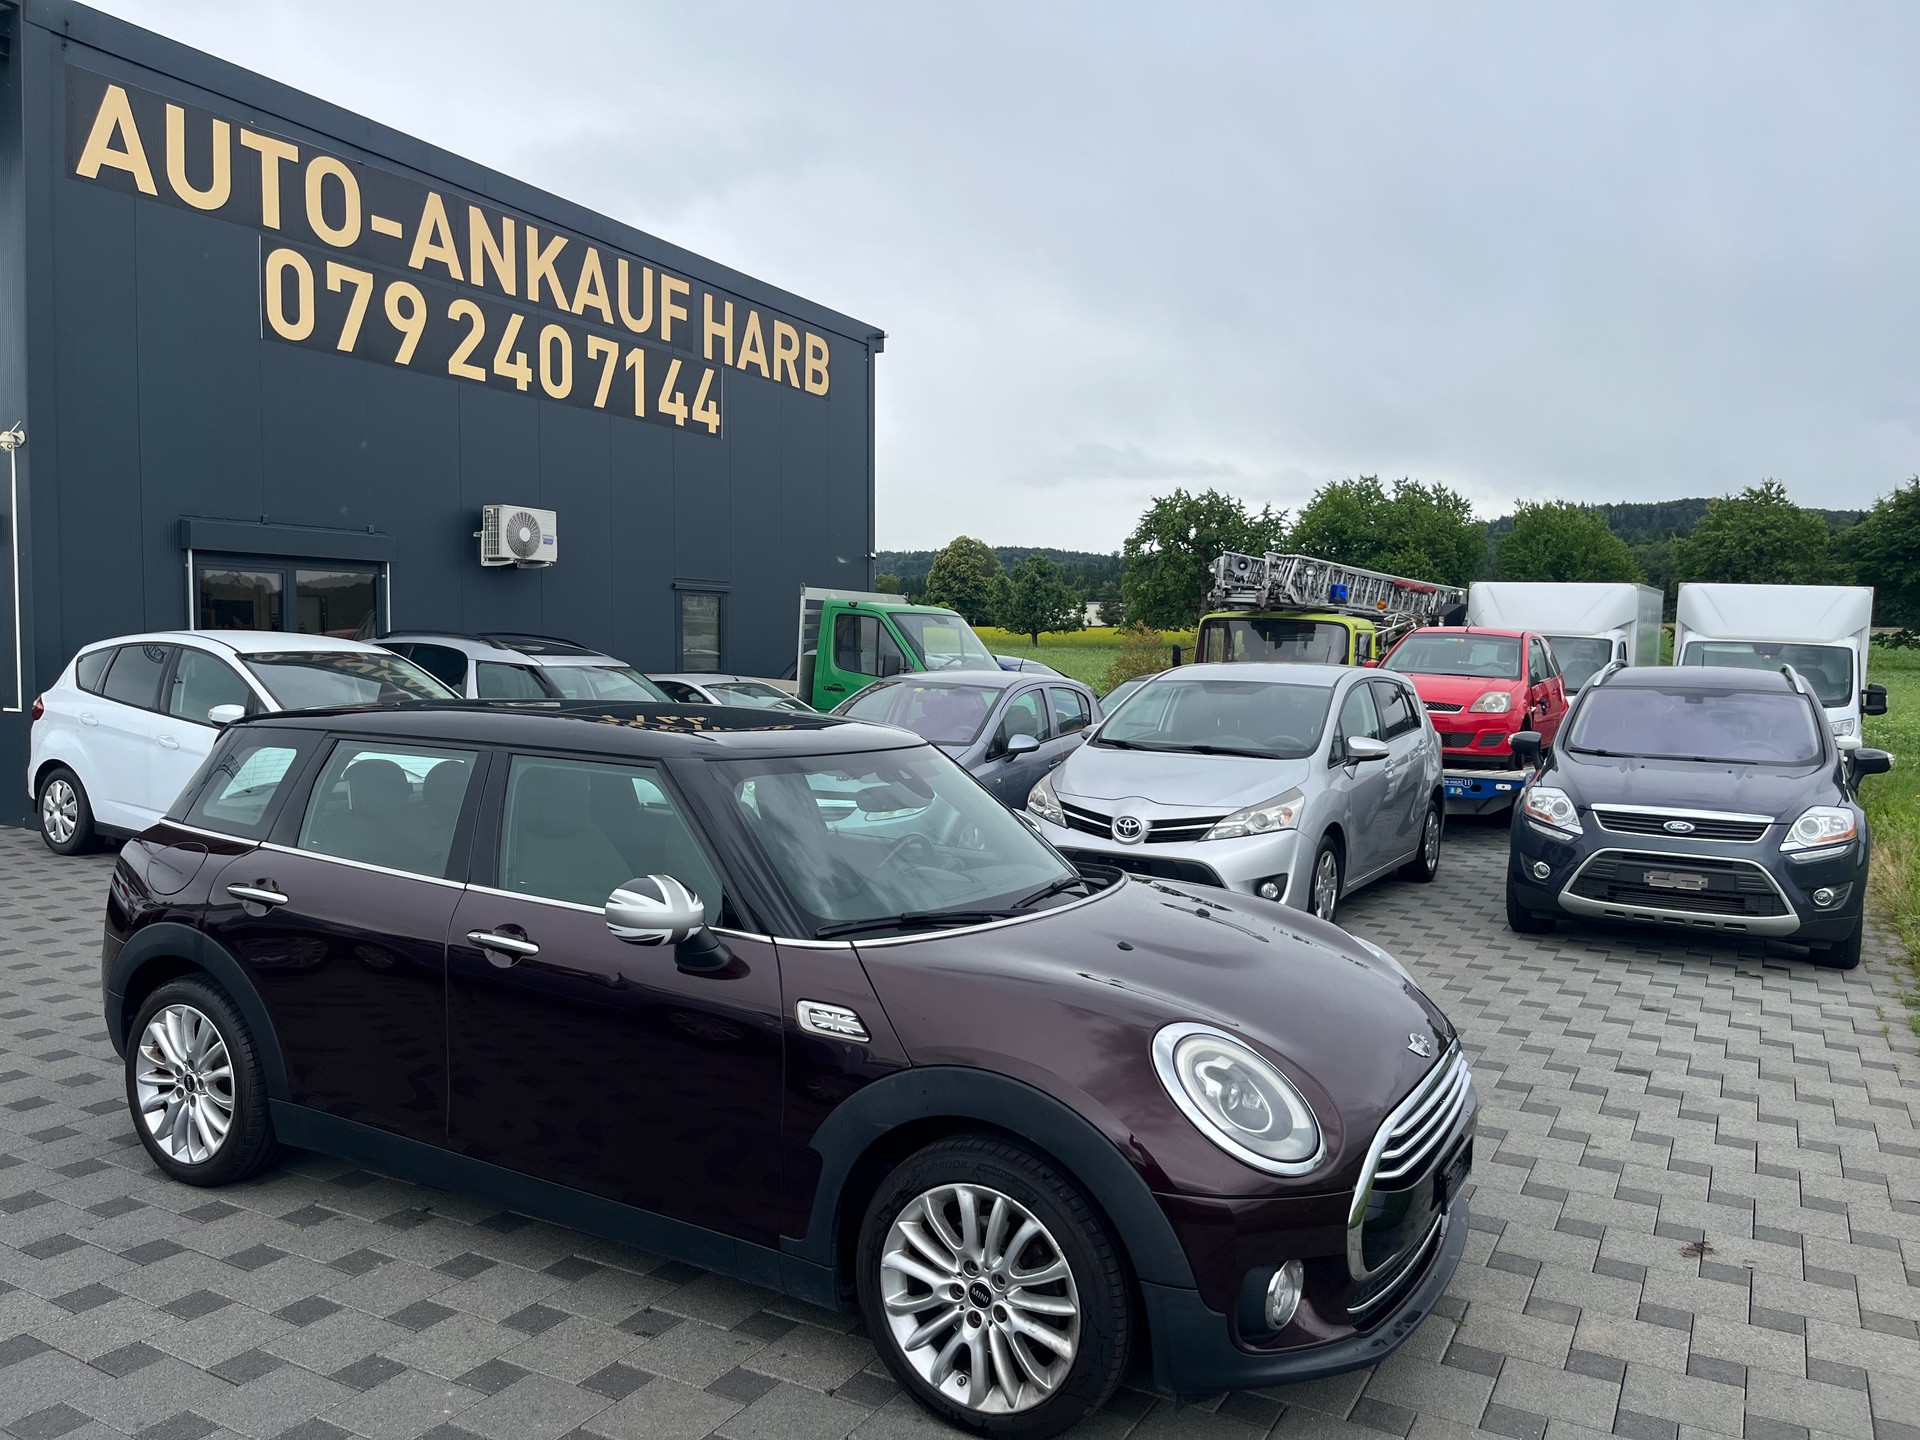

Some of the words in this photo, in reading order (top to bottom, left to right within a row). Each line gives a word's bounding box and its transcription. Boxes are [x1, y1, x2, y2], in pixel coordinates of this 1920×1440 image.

[76, 84, 690, 341] AUTO-ANKAUF
[703, 293, 830, 395] HARB
[266, 248, 427, 365] 079
[447, 299, 573, 399] 240
[971, 1287, 989, 1304] MINI
